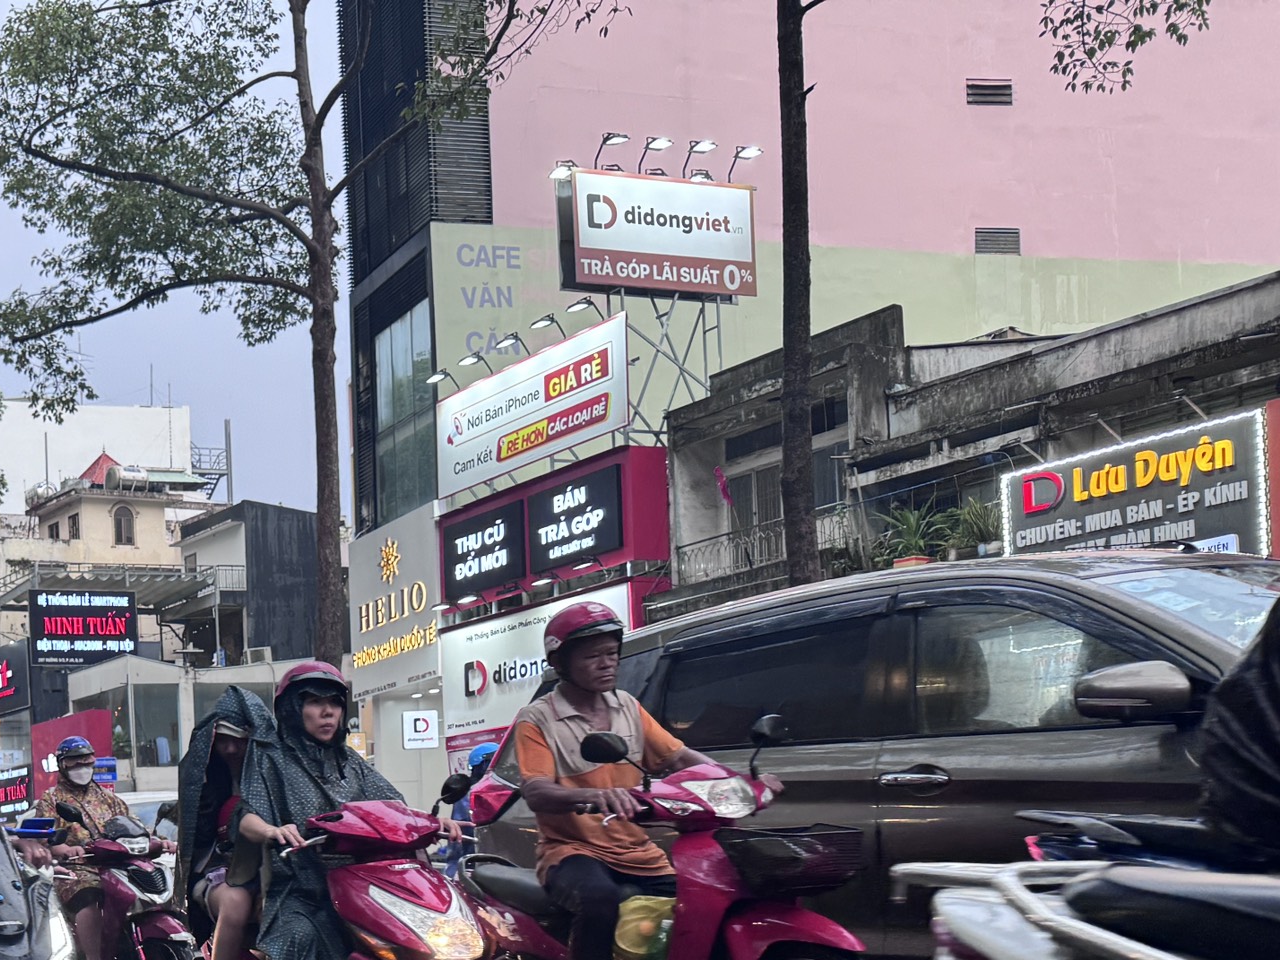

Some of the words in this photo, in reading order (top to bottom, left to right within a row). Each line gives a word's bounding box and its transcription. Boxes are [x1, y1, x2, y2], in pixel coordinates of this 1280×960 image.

[456, 243, 521, 269] CAFE
[580, 256, 614, 276] TRẢ
[616, 258, 650, 279] GÓP
[653, 262, 677, 281] LÃI
[680, 265, 720, 285] SUẤT
[460, 281, 513, 308] VĂN
[467, 413, 484, 431] Nơi
[485, 405, 504, 422] Bán
[505, 389, 540, 413] iPhone
[549, 364, 577, 398] GIÁ
[580, 353, 602, 384] RẺ
[453, 456, 475, 475] Cam
[476, 445, 493, 466] Kết
[506, 434, 520, 455] RẺ
[521, 426, 546, 449] HƠN
[547, 417, 567, 435] CÁC
[568, 409, 591, 426] LOẠI
[592, 397, 606, 418] RẺ
[1073, 463, 1128, 502] Lưu
[1135, 435, 1234, 487] Duyên
[553, 486, 587, 513] BÁN
[1016, 518, 1082, 548] CHUYÊN:
[1085, 508, 1123, 533] MUA
[1126, 499, 1163, 525] BÁN
[1177, 490, 1200, 514] ÉP
[1204, 480, 1249, 508] KÍNH
[454, 530, 482, 554] THU
[484, 519, 505, 545] CŨ
[538, 516, 570, 545] TRẢ
[571, 506, 604, 535] GÓP
[1153, 519, 1196, 542] HÌNH
[454, 551, 480, 581] ĐỔI
[481, 546, 508, 573] MỚI
[43, 617, 84, 635] MINH
[86, 611, 126, 635] TUẤN
[358, 581, 426, 633] HELIO
[352, 646, 378, 669] PHÒNG
[378, 636, 399, 661] KHÁM
[400, 625, 425, 653] QUỐC
